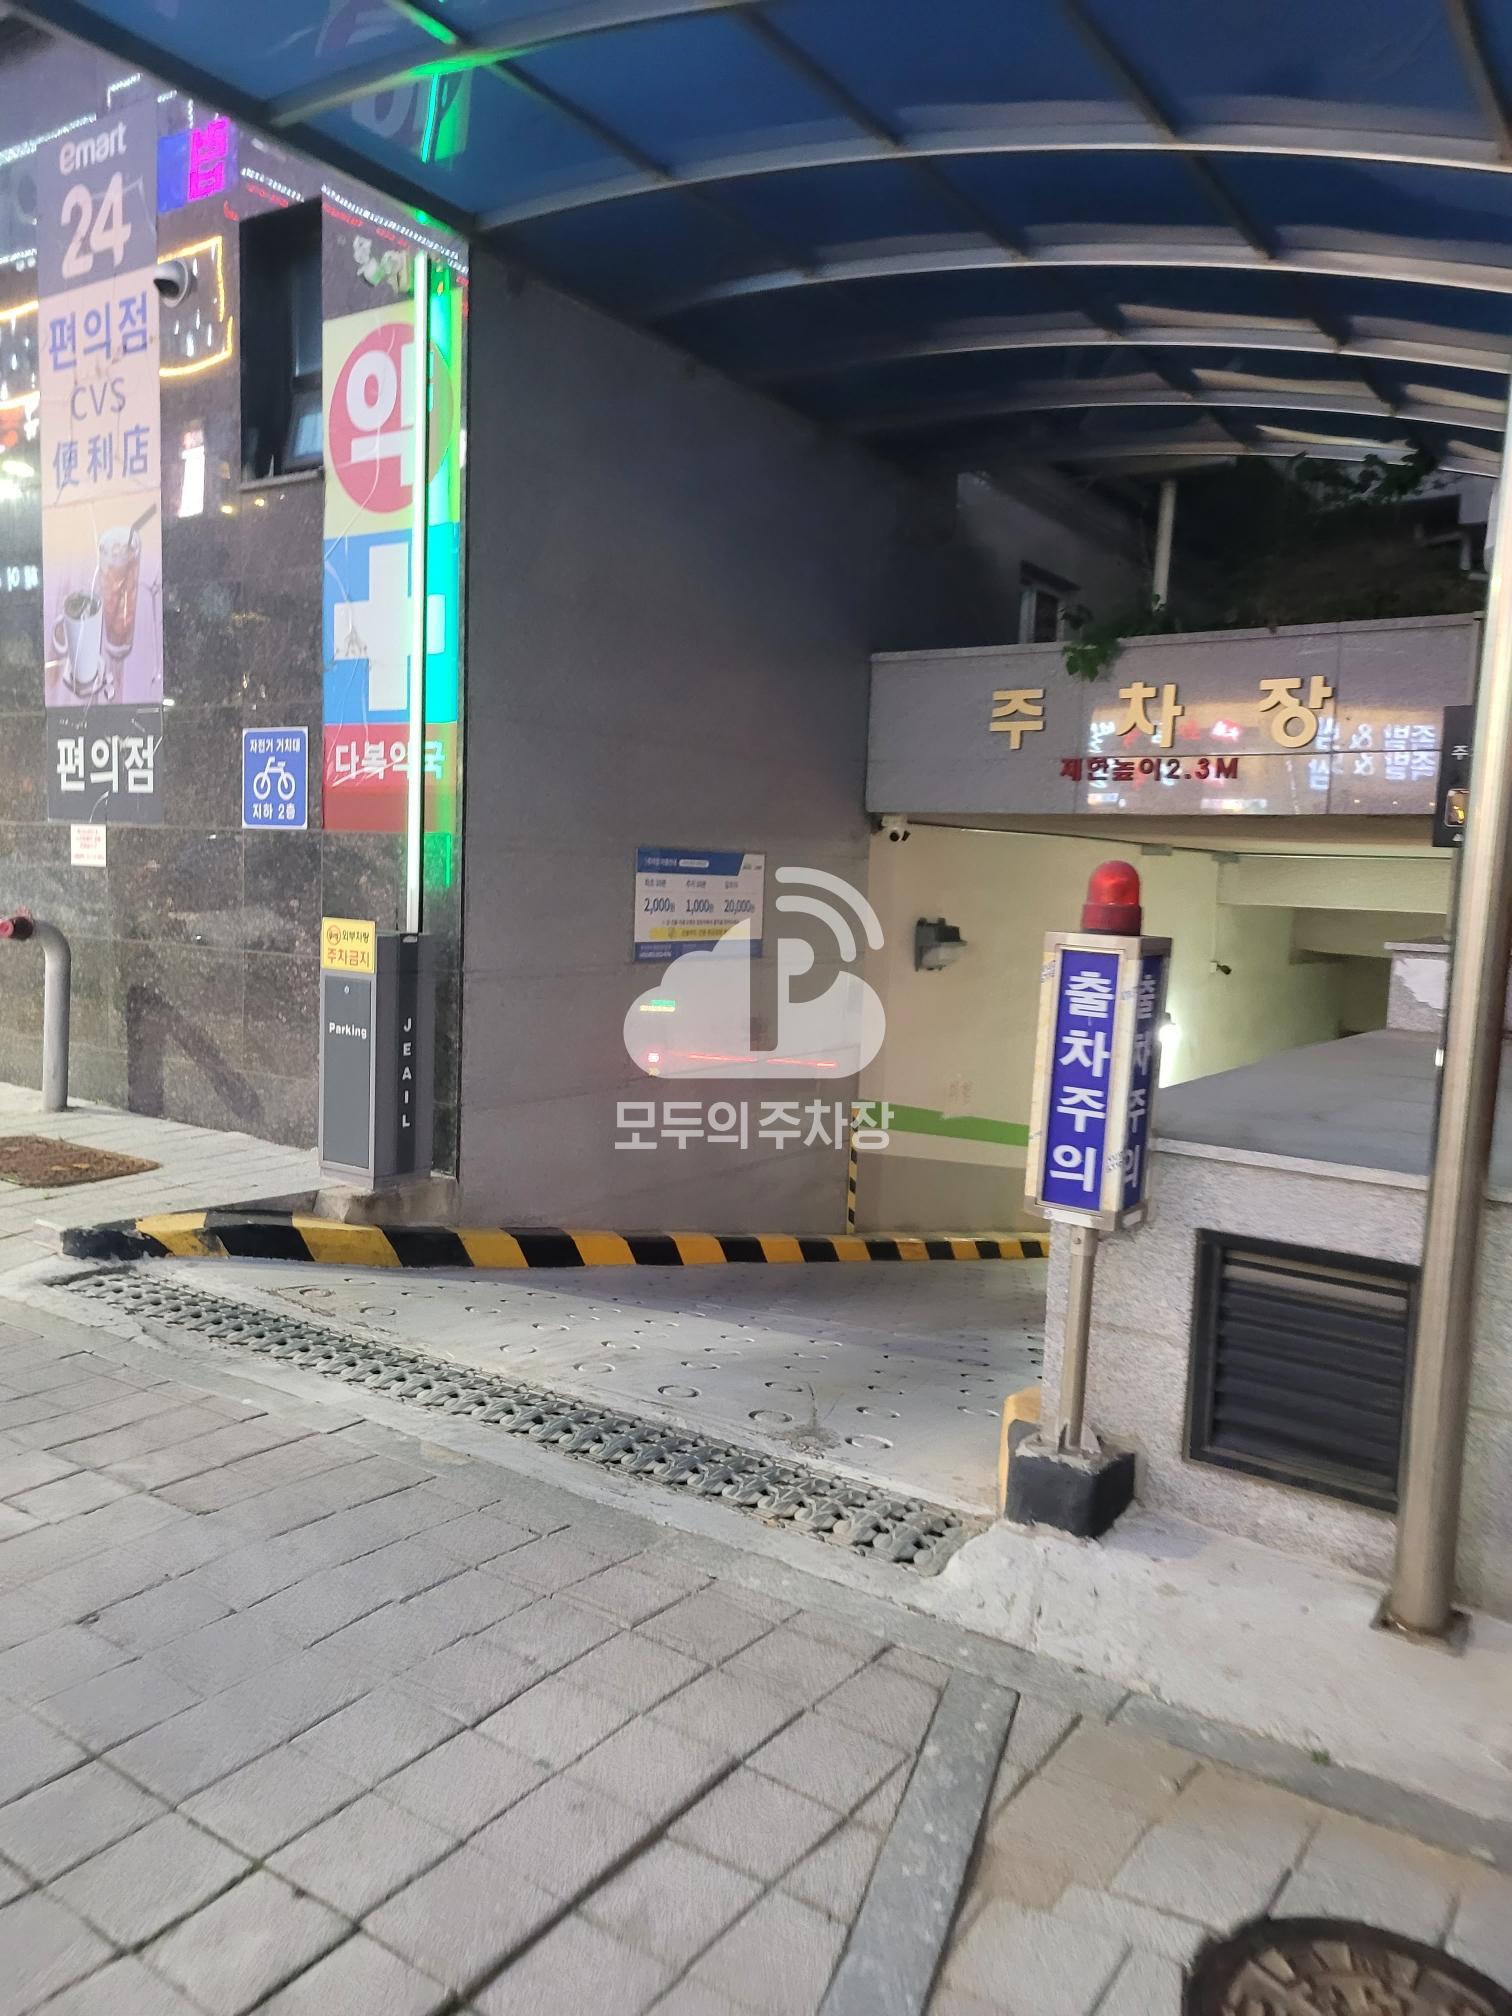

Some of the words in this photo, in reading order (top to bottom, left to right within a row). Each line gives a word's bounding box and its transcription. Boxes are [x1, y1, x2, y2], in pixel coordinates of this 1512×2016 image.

[59, 121, 127, 176] emart
[61, 171, 131, 279] 24
[49, 289, 148, 372] 편의점
[71, 377, 126, 421] CVS
[53, 424, 150, 489] 便利店
[989, 675, 1334, 750] 주차장
[57, 735, 155, 793] 편의점
[277, 738, 300, 753] 거치대
[253, 803, 273, 819] 지하
[328, 948, 370, 968] 주차금지
[329, 1022, 367, 1040] Parking
[402, 1018, 413, 1128] JEAIL
